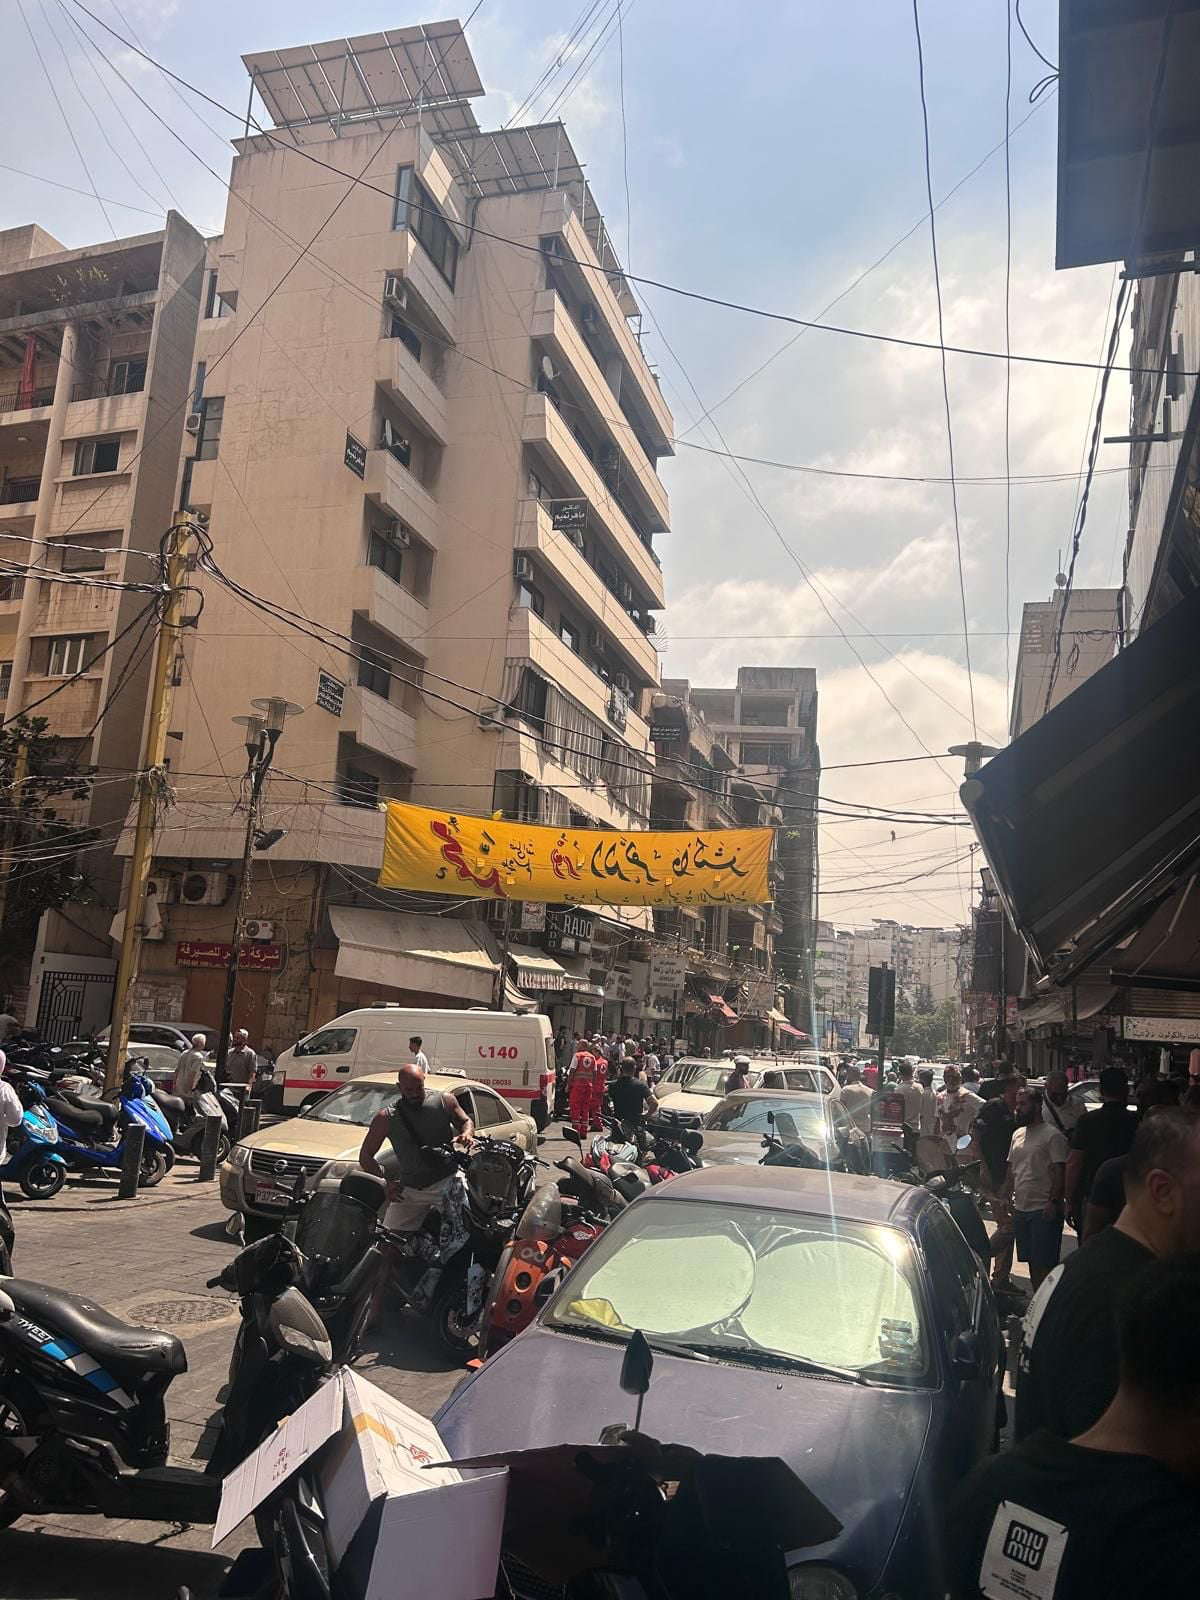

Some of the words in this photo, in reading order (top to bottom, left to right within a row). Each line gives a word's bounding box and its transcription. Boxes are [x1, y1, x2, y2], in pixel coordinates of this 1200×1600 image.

[563, 914, 593, 940] RADO
[488, 1045, 518, 1060] 140
[17, 1318, 55, 1341] TWEET
[1011, 1526, 1044, 1550] MIU
[1007, 1540, 1040, 1566] MIU
